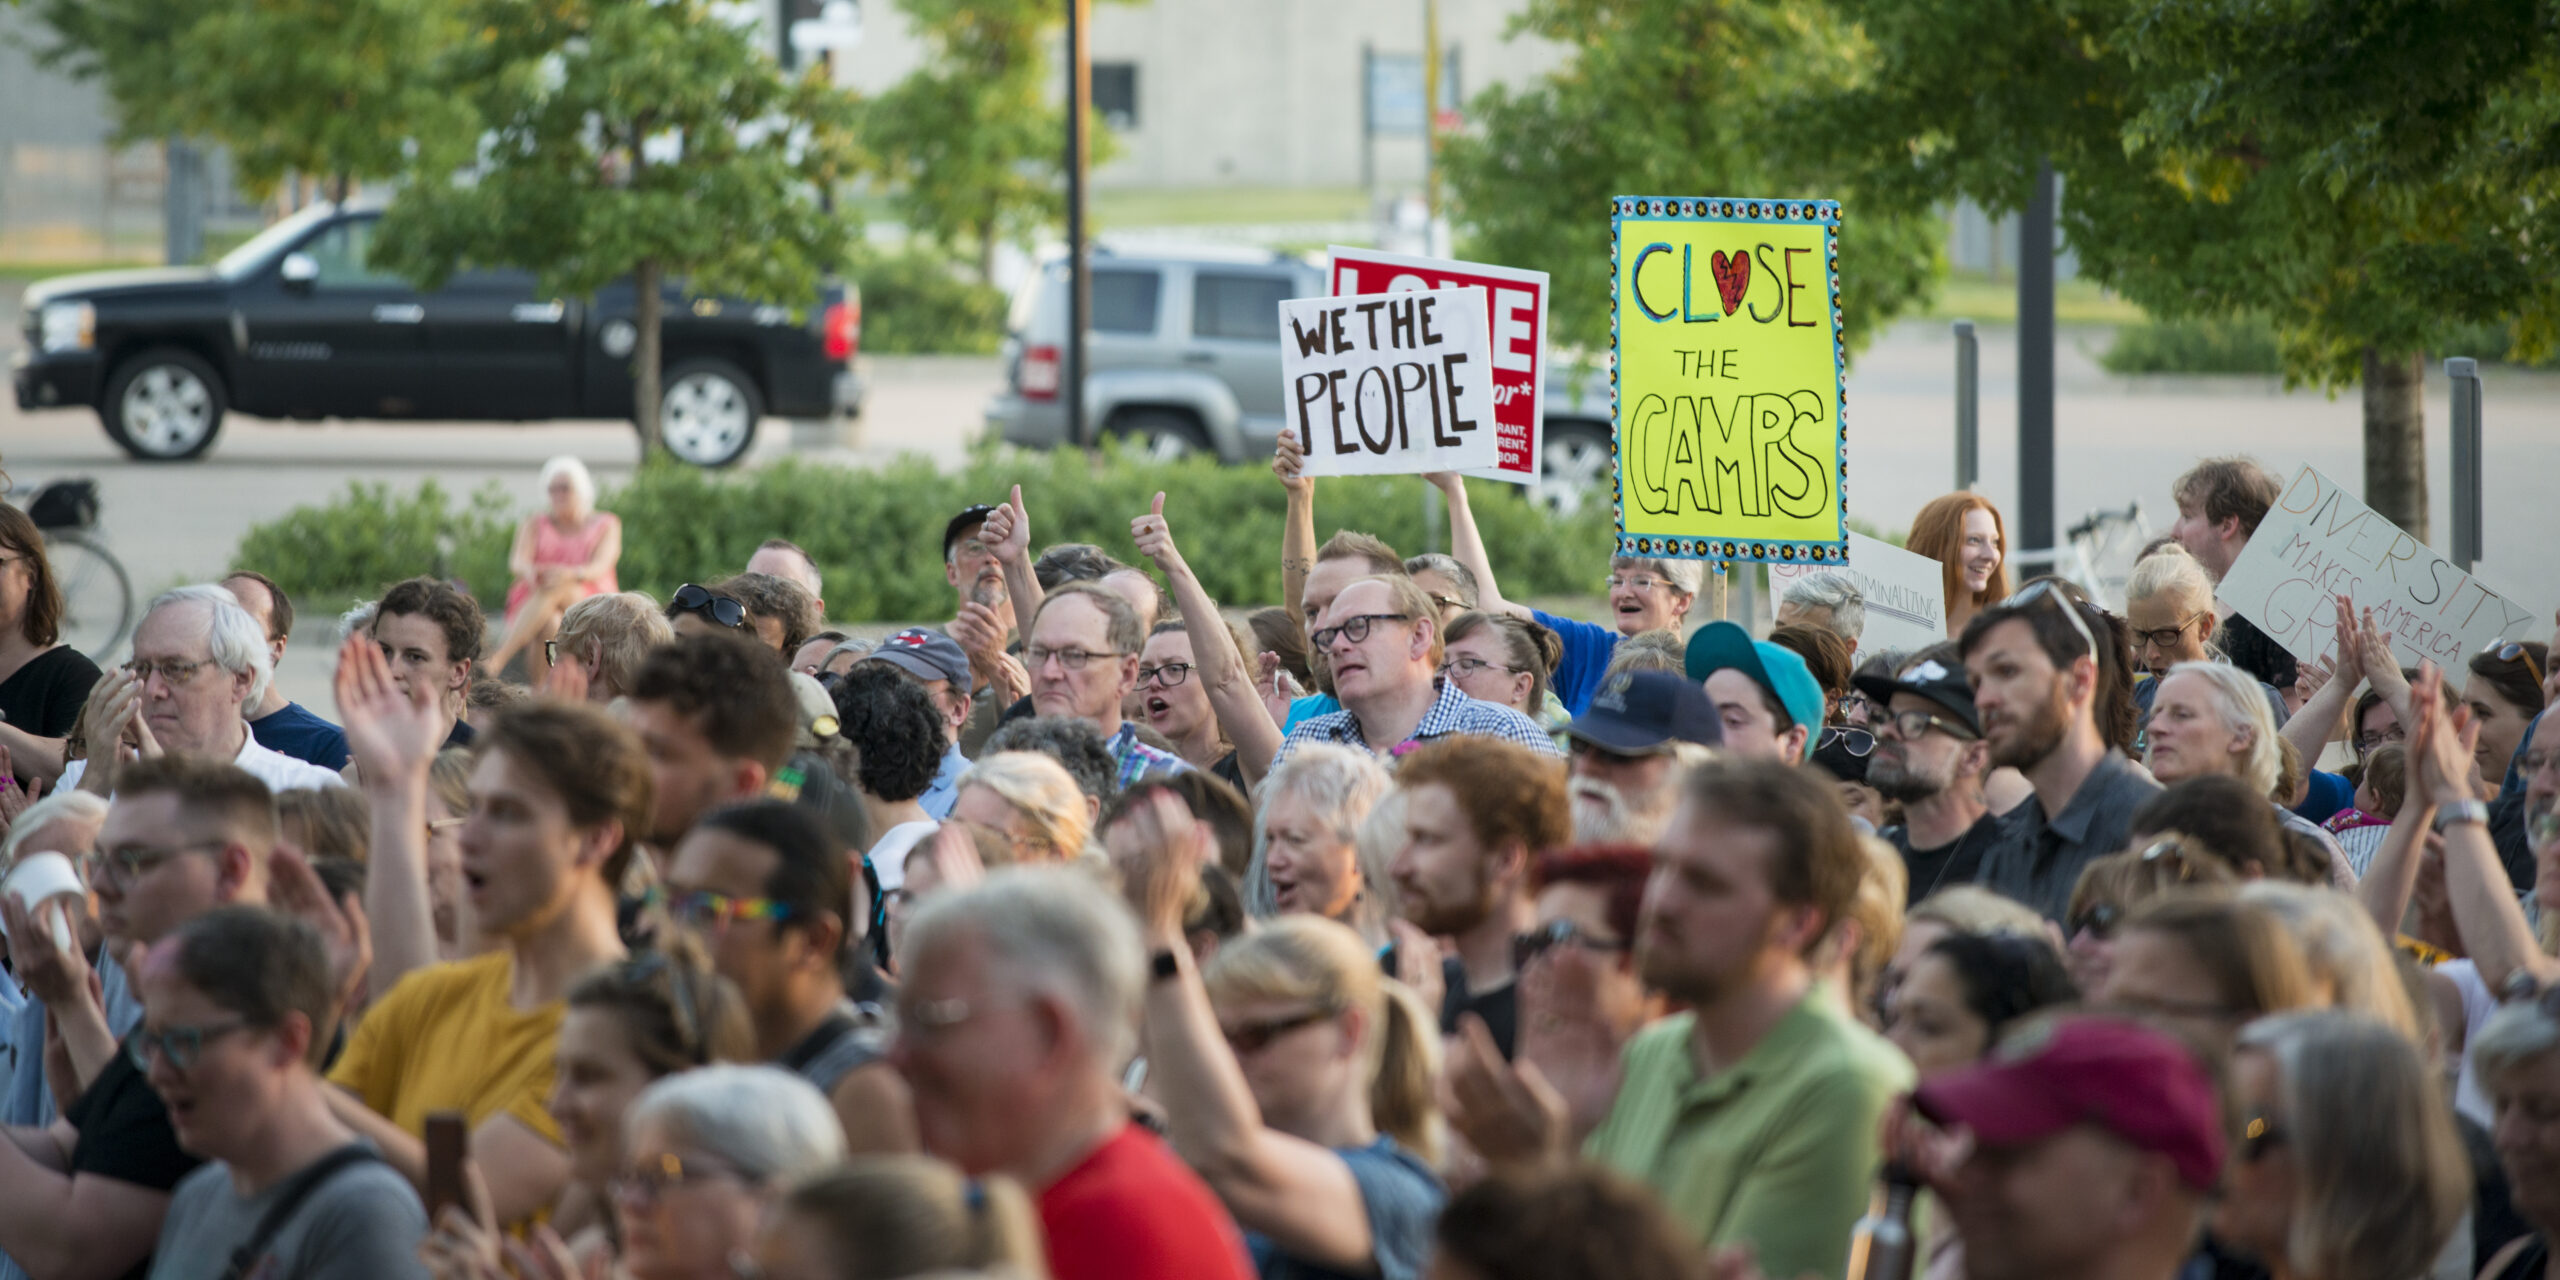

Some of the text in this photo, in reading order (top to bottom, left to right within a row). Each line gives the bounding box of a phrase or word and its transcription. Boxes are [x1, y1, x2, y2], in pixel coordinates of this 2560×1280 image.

[1292, 308, 1354, 359] WE
[1355, 296, 1443, 350] THE
[1673, 349, 1739, 380] THE
[1295, 353, 1478, 456] PEOPLE
[1630, 390, 1828, 519] CAMPS
[2279, 533, 2362, 601] MAKES
[2280, 467, 2532, 638] DIVERSITY
[2372, 599, 2462, 663] AMERICA
